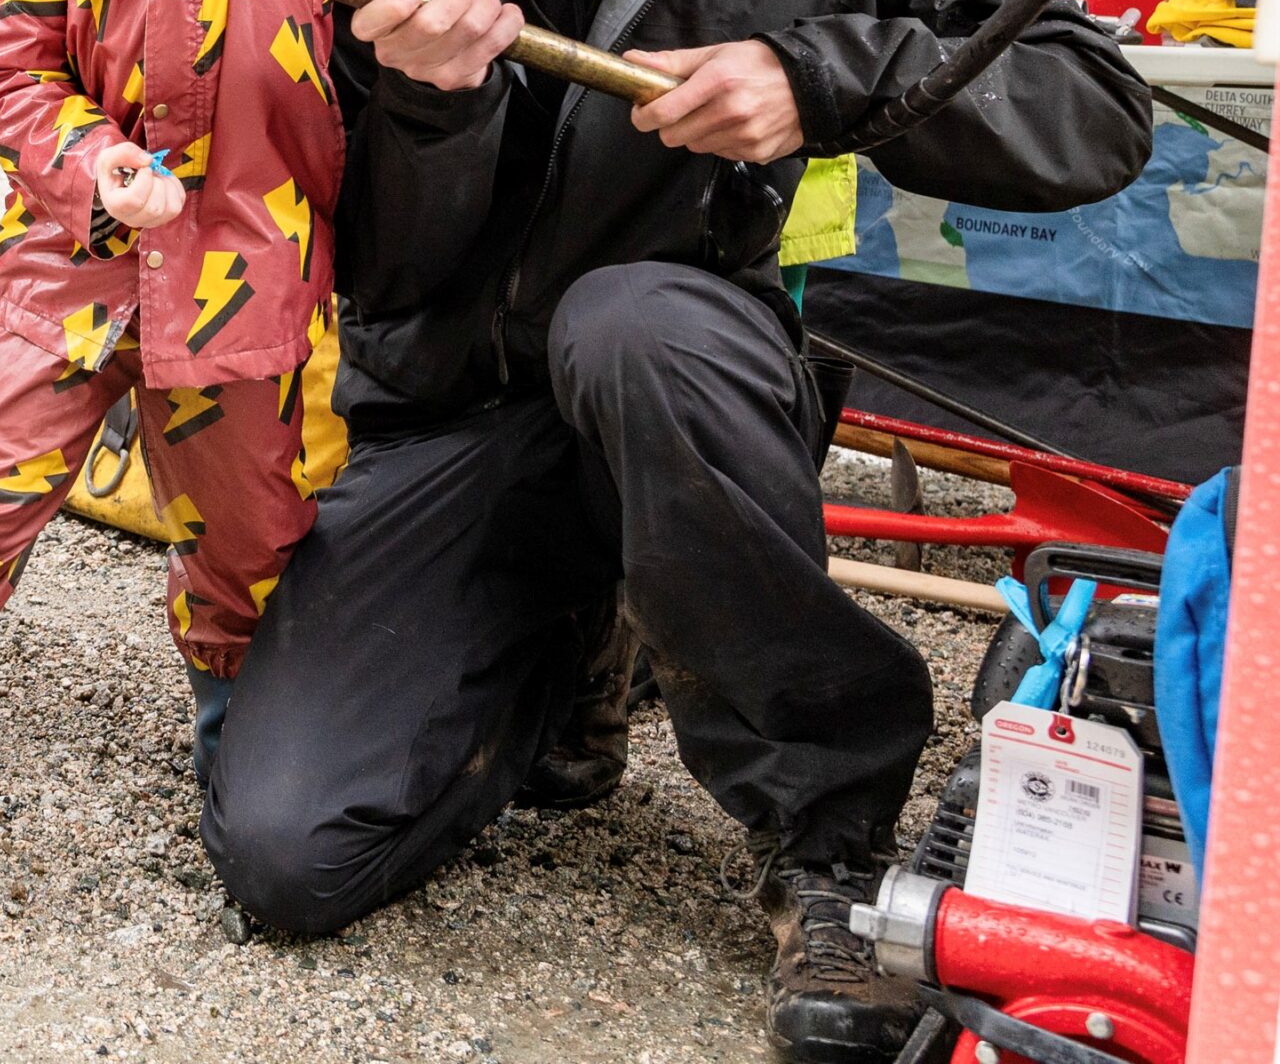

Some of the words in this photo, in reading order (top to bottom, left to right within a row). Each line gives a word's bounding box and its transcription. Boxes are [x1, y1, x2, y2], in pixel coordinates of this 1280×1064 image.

[1205, 89, 1237, 103] DELTA
[956, 217, 1027, 239] BOUNDARY
[1030, 226, 1057, 242] BAY
